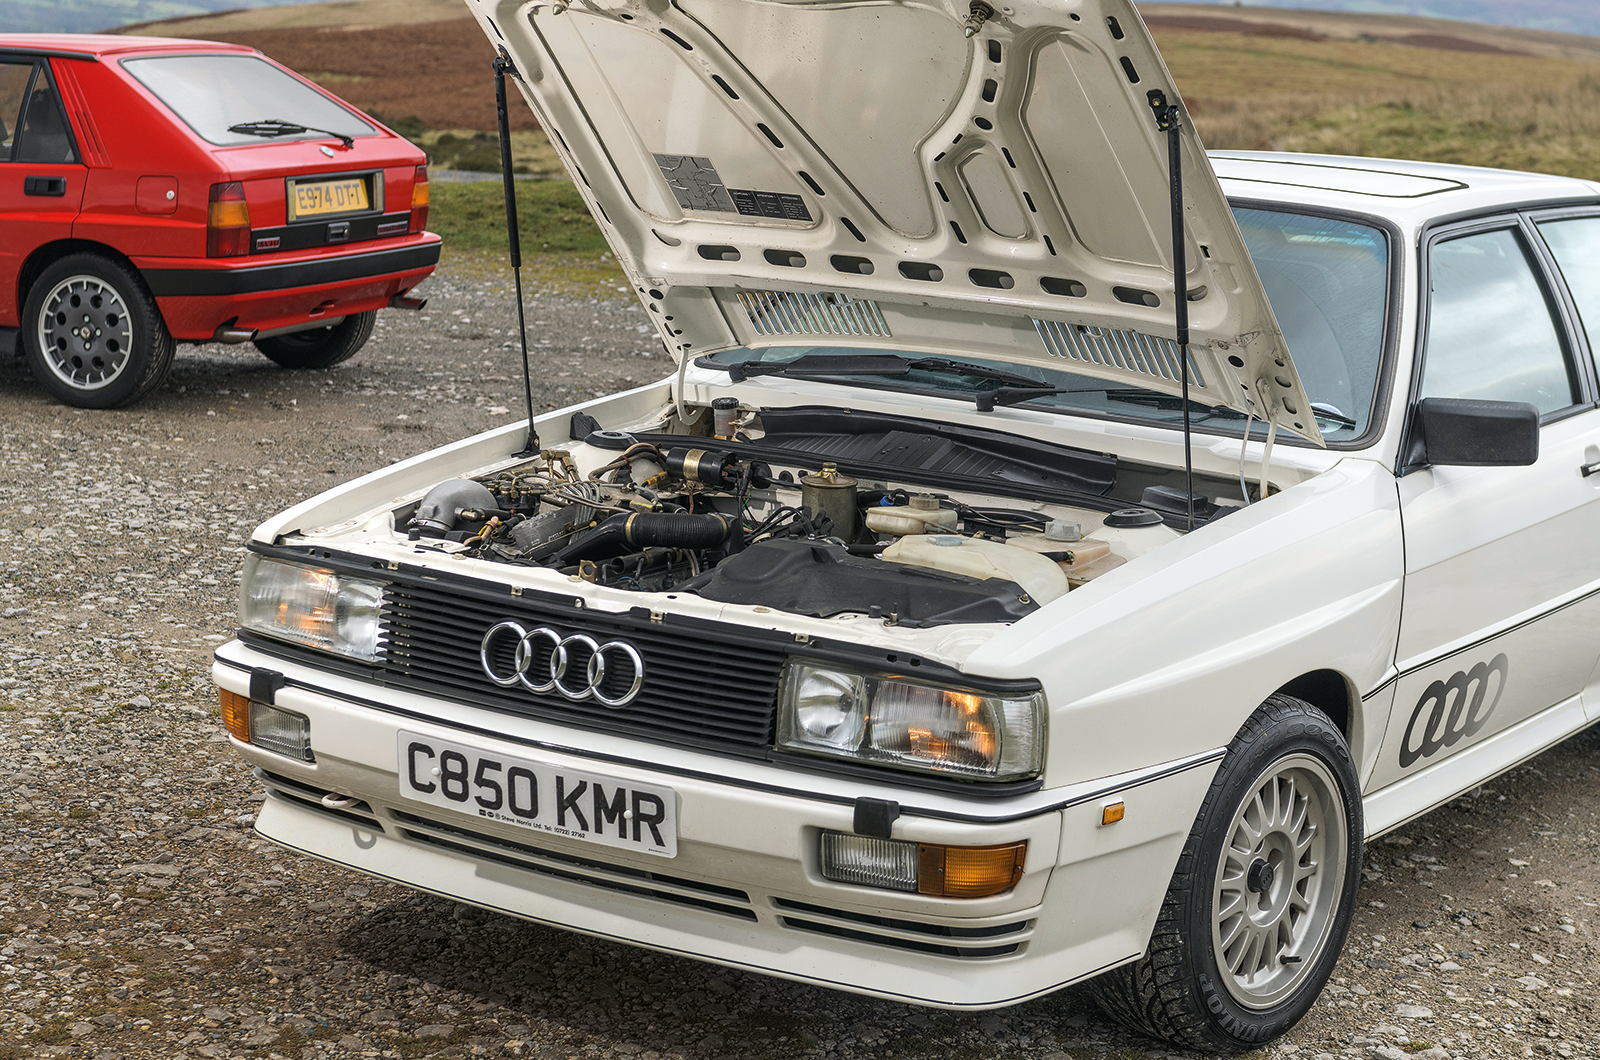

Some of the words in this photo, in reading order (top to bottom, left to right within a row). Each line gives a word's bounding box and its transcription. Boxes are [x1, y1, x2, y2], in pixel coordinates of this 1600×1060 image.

[297, 185, 333, 210] E974
[334, 183, 360, 207] DTT
[1284, 723, 1350, 763] 9000
[407, 741, 539, 820] C850
[555, 775, 666, 848] KMR
[501, 815, 515, 823] Steve
[516, 818, 532, 827] Norris
[533, 822, 543, 830] Ltd.
[1198, 972, 1277, 1042] DUNLOP
